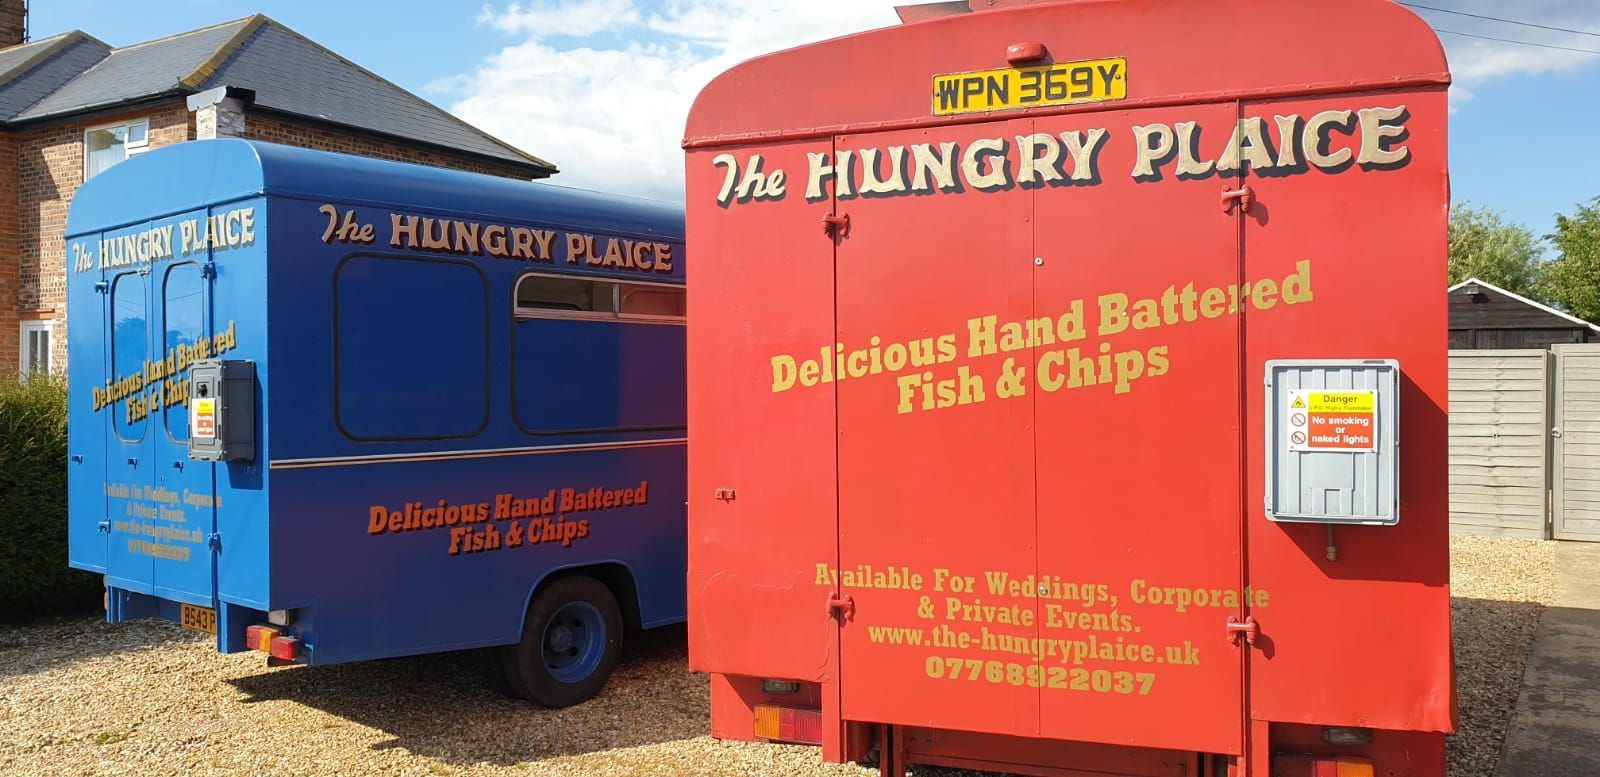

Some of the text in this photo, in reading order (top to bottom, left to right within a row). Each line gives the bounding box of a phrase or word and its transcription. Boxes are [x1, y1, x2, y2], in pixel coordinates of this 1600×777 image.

[938, 63, 1120, 110] WPN 369Y
[712, 105, 1412, 209] The HUNGRY PLAICE
[73, 206, 257, 273] The HUNGRY PLAICE
[319, 203, 674, 274] The HUNGRY PLAICE
[770, 259, 1314, 393] Delicious Hand Battered
[92, 319, 237, 412] Delicious Hand Battered
[897, 342, 1170, 415] Fish & Chips
[126, 391, 148, 426] Fish
[1312, 415, 1369, 427] No smoking
[1323, 394, 1358, 405] Danger
[1312, 434, 1369, 445] naked lights
[1335, 426, 1346, 434] or
[367, 481, 649, 535] Delicious Hand Battered
[448, 515, 590, 556] Fish & Chips
[814, 562, 1270, 612] Available For Weddings, Corporate
[184, 606, 208, 629] B543
[917, 596, 1142, 633] & Private Events.
[868, 623, 1200, 666] www.the-hungryplaice.uk
[925, 656, 1156, 696] 07768922037
